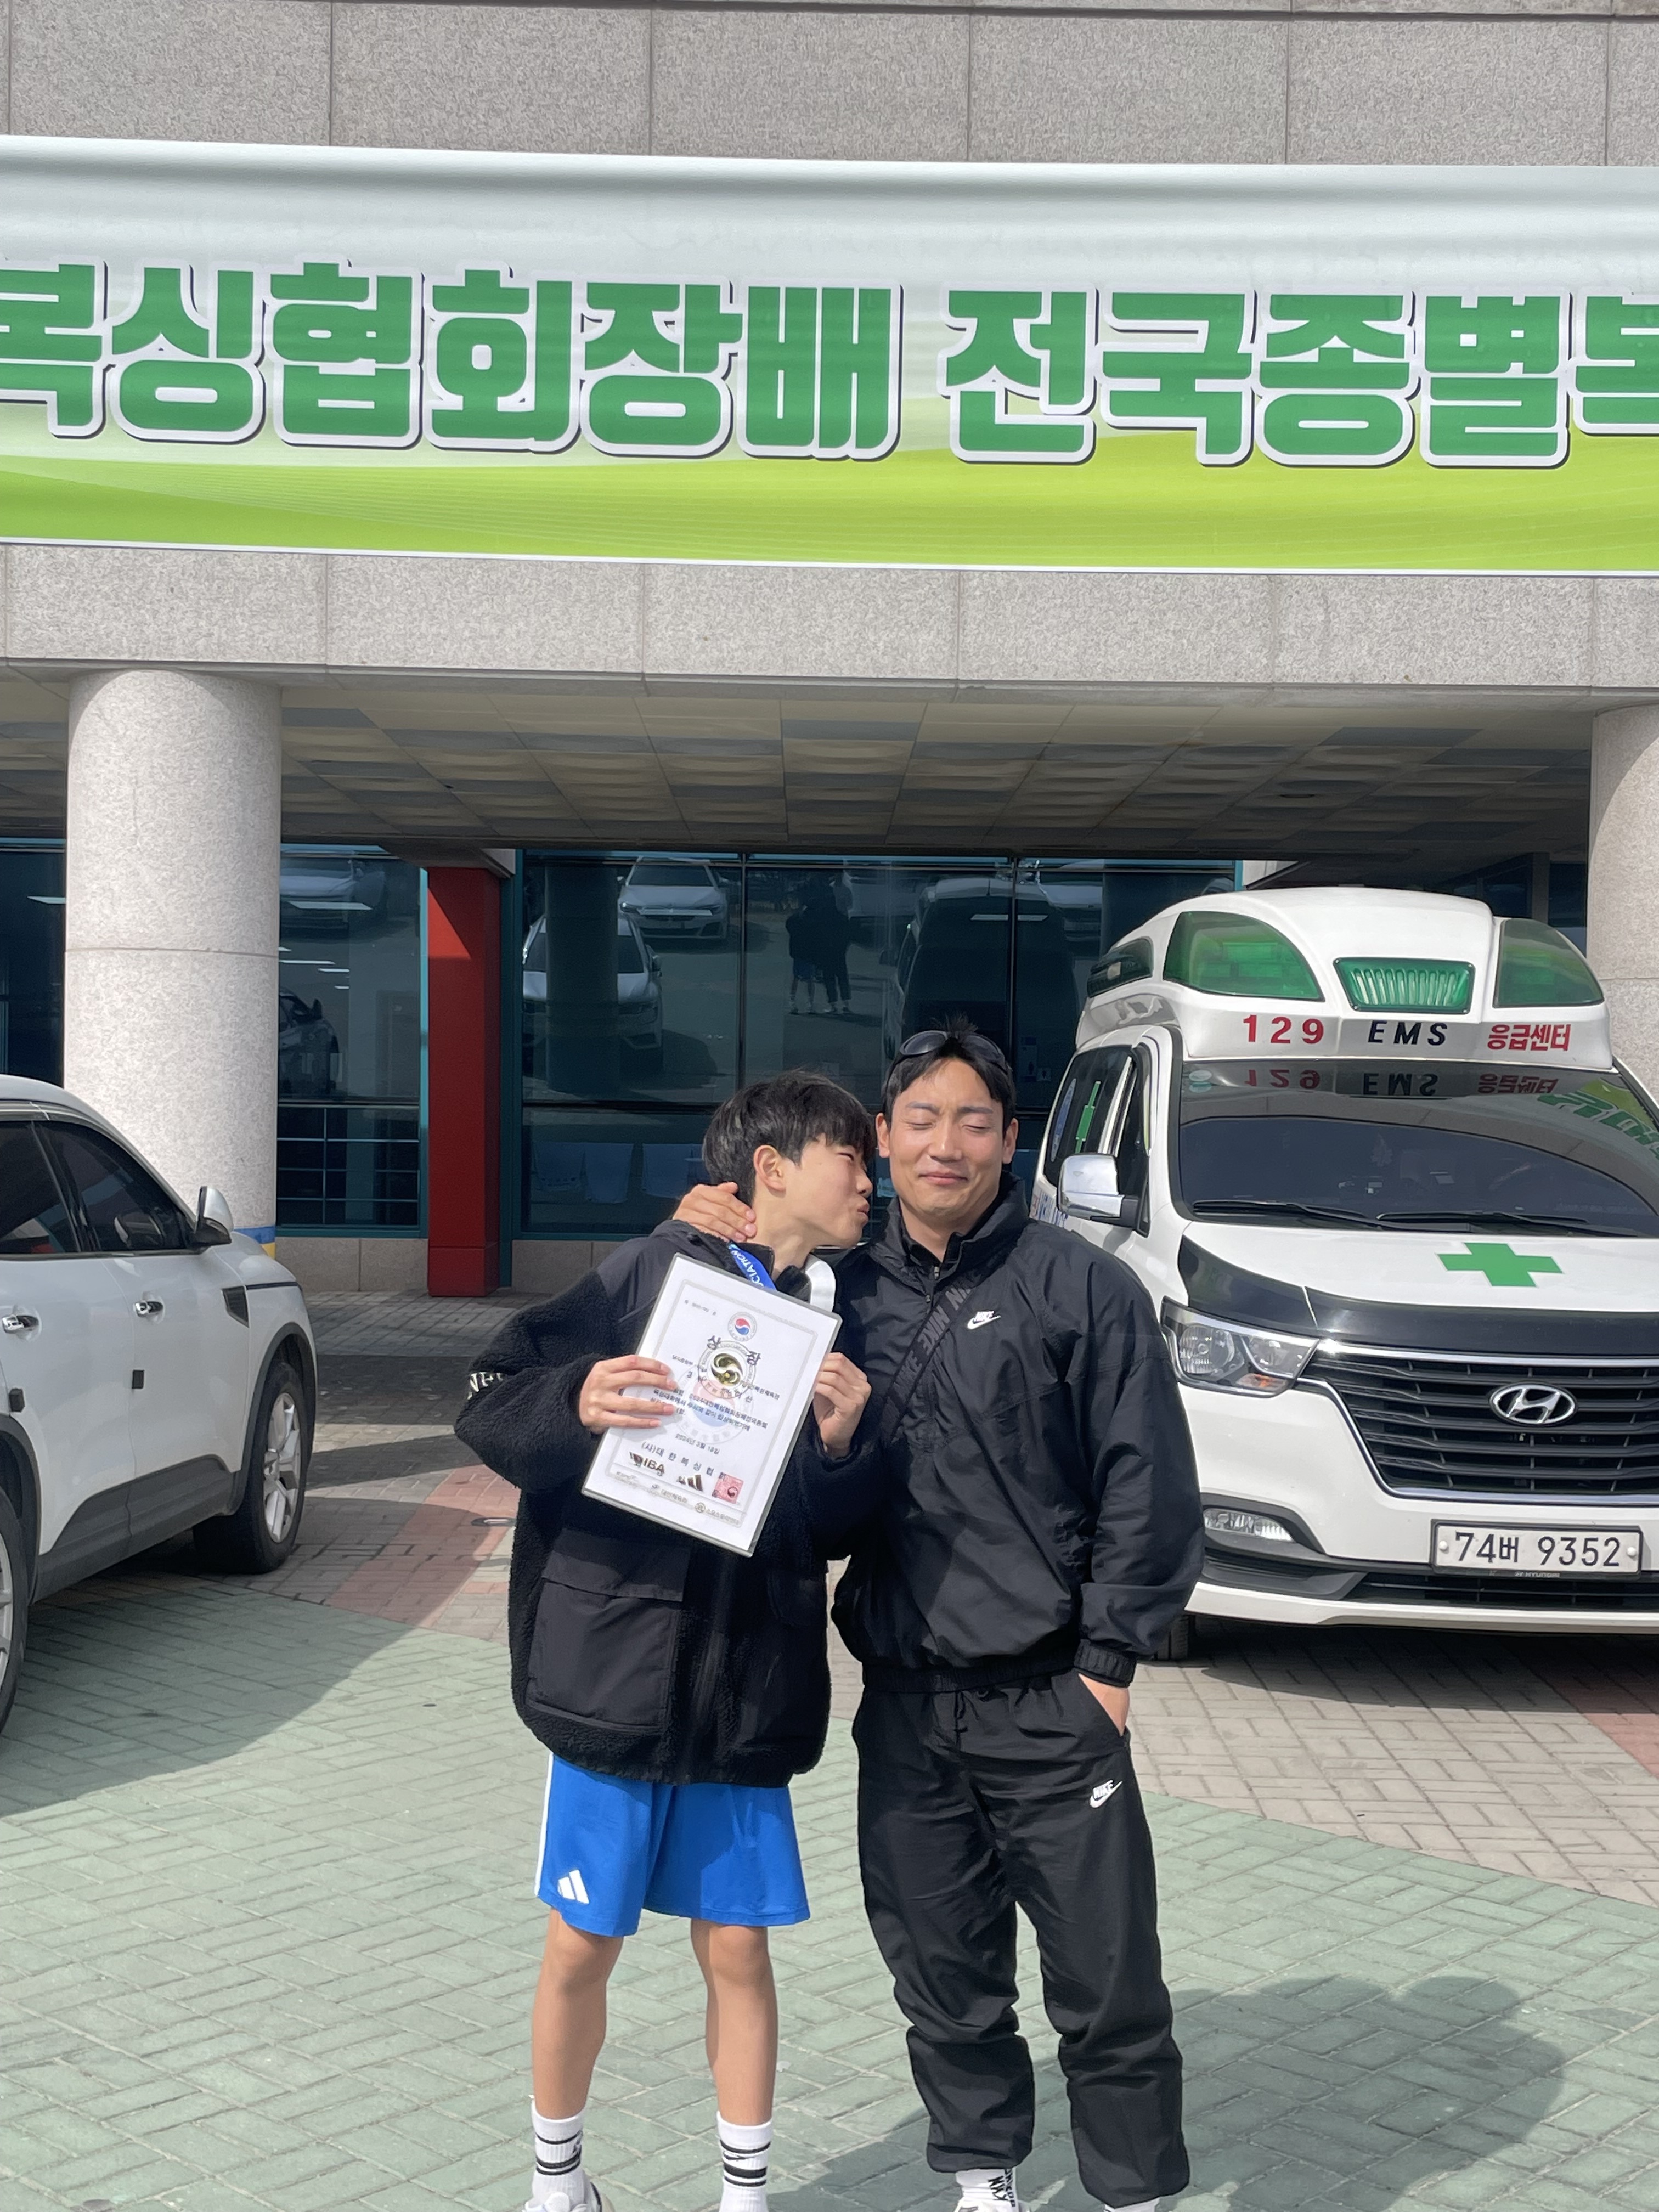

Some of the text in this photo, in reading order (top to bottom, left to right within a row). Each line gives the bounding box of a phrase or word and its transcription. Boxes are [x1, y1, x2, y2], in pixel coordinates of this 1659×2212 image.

[1243, 1014, 1571, 1052] 129 EMS 응급센터
[642, 1458, 666, 1474] IBA
[1455, 1531, 1621, 1567] 74버 9352
